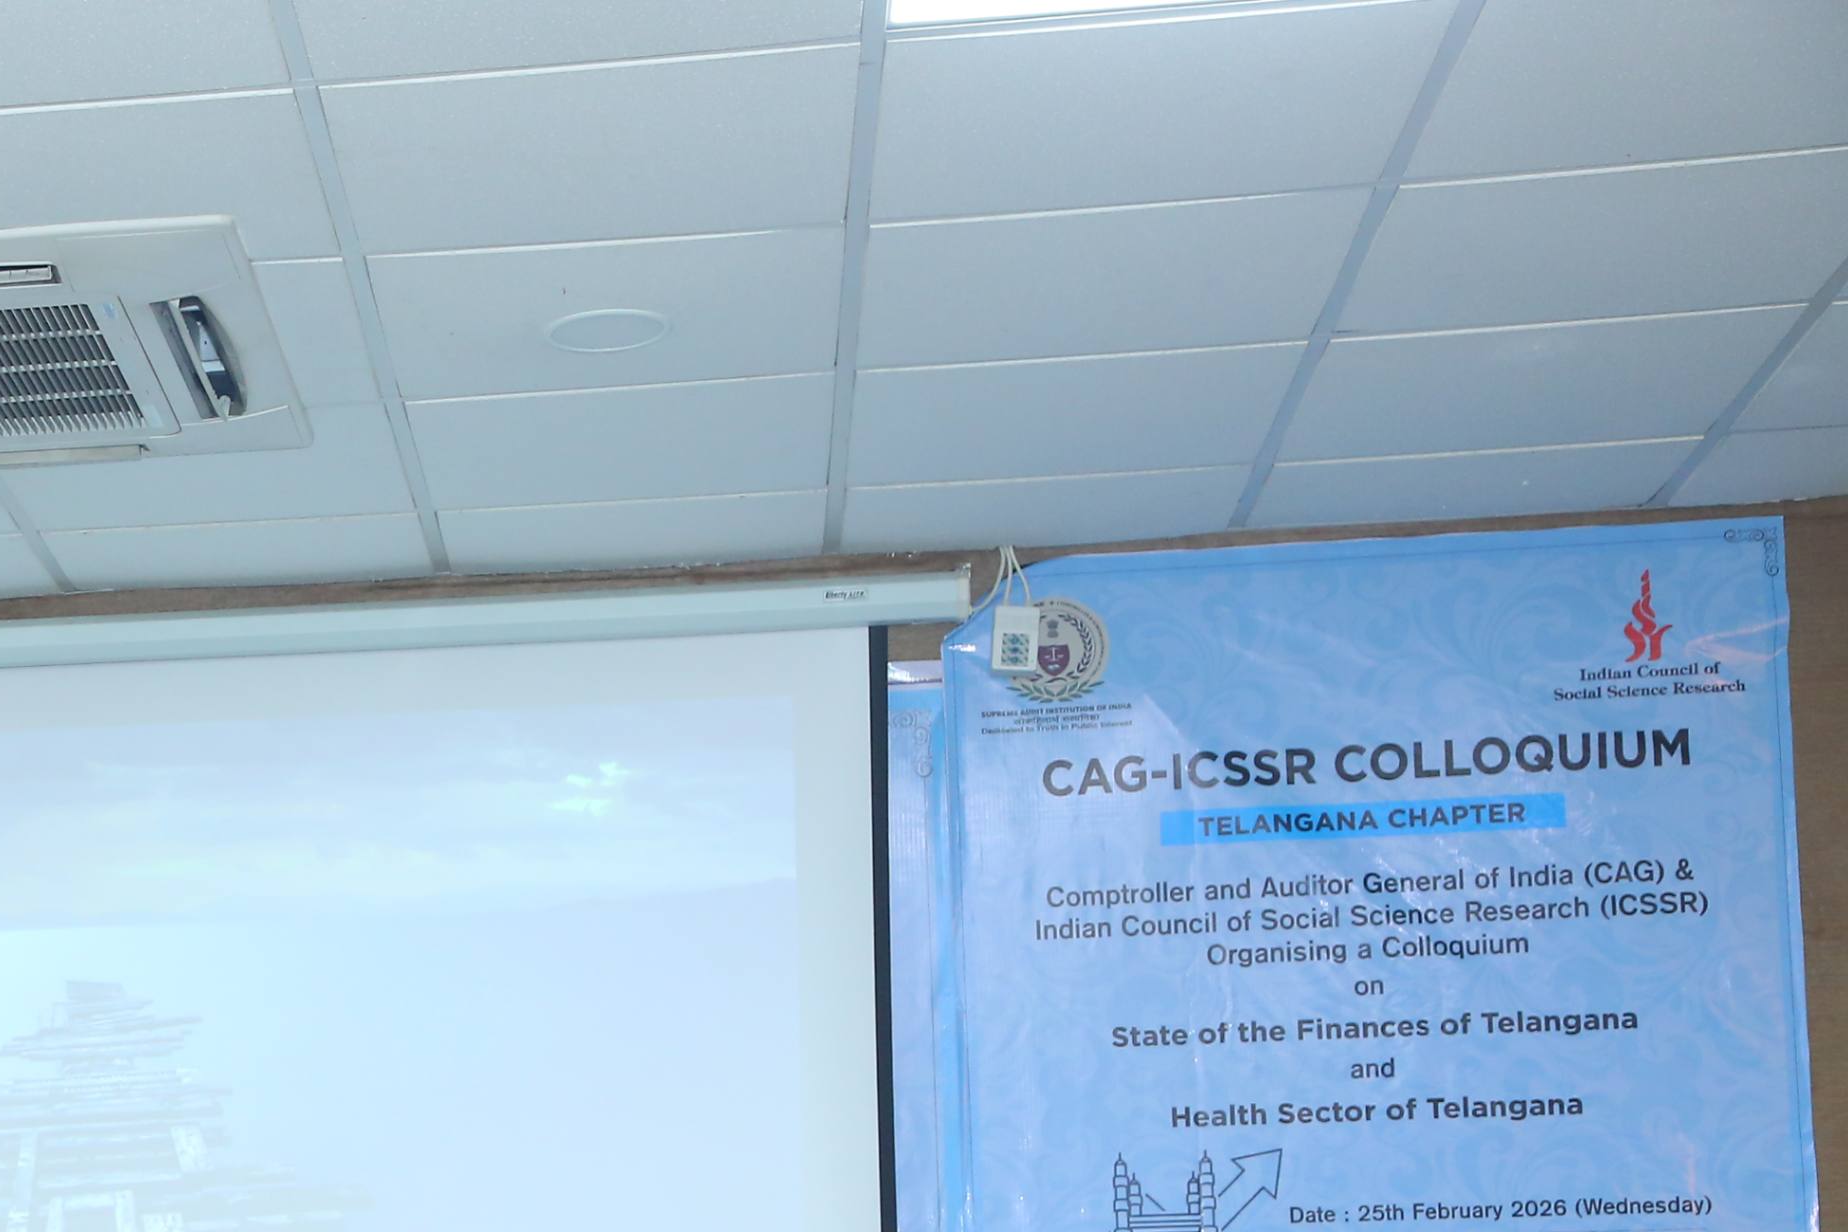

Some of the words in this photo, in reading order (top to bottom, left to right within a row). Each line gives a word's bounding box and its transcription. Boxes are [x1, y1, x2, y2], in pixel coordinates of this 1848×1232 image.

[1580, 668, 1631, 681] Indian
[1637, 663, 1698, 677] Council
[1704, 662, 1720, 674] of
[1554, 686, 1601, 701] Social
[1607, 686, 1667, 698] Science
[1674, 679, 1745, 694] Research
[1043, 748, 1316, 796] CAG-ICSSR
[1335, 728, 1690, 782] COLLOQUIUM
[1199, 810, 1378, 836] TELANGANA
[1388, 803, 1524, 828] CHAPTER
[1047, 882, 1194, 909] Comptroller
[1205, 877, 1250, 900] and
[1261, 874, 1353, 898] Auditor
[1363, 868, 1464, 894] General
[1475, 867, 1499, 889] of
[1510, 864, 1573, 888] India
[1584, 860, 1664, 888] (CAG)
[1675, 858, 1694, 880] &
[1036, 918, 1111, 940] Indian
[1122, 912, 1216, 936] Council
[1227, 910, 1251, 932] of
[1261, 906, 1339, 930] Social
[1351, 904, 1454, 926] Science
[1465, 896, 1589, 922] Research
[1601, 891, 1708, 920] (ICSSR)
[1207, 940, 1346, 968] Organising
[1358, 944, 1372, 959] a
[1382, 934, 1528, 959] Colloquium
[1354, 980, 1384, 996] on
[1112, 1026, 1188, 1047] State
[1198, 1022, 1228, 1044] of
[1238, 1021, 1285, 1043] the
[1297, 1018, 1429, 1040] Finances
[1441, 1013, 1471, 1035] of
[1481, 1011, 1638, 1035] Telangana
[1351, 1057, 1395, 1079] and
[1172, 1103, 1267, 1127] Health
[1278, 1102, 1376, 1124] Sector
[1386, 1098, 1417, 1120] of
[1426, 1096, 1583, 1121] Telangana
[1290, 1206, 1336, 1223] Date
[1358, 1204, 1404, 1222] 25th
[1413, 1202, 1503, 1221] February
[1511, 1199, 1567, 1217] 2026
[1575, 1196, 1712, 1218] (Wednesday)
